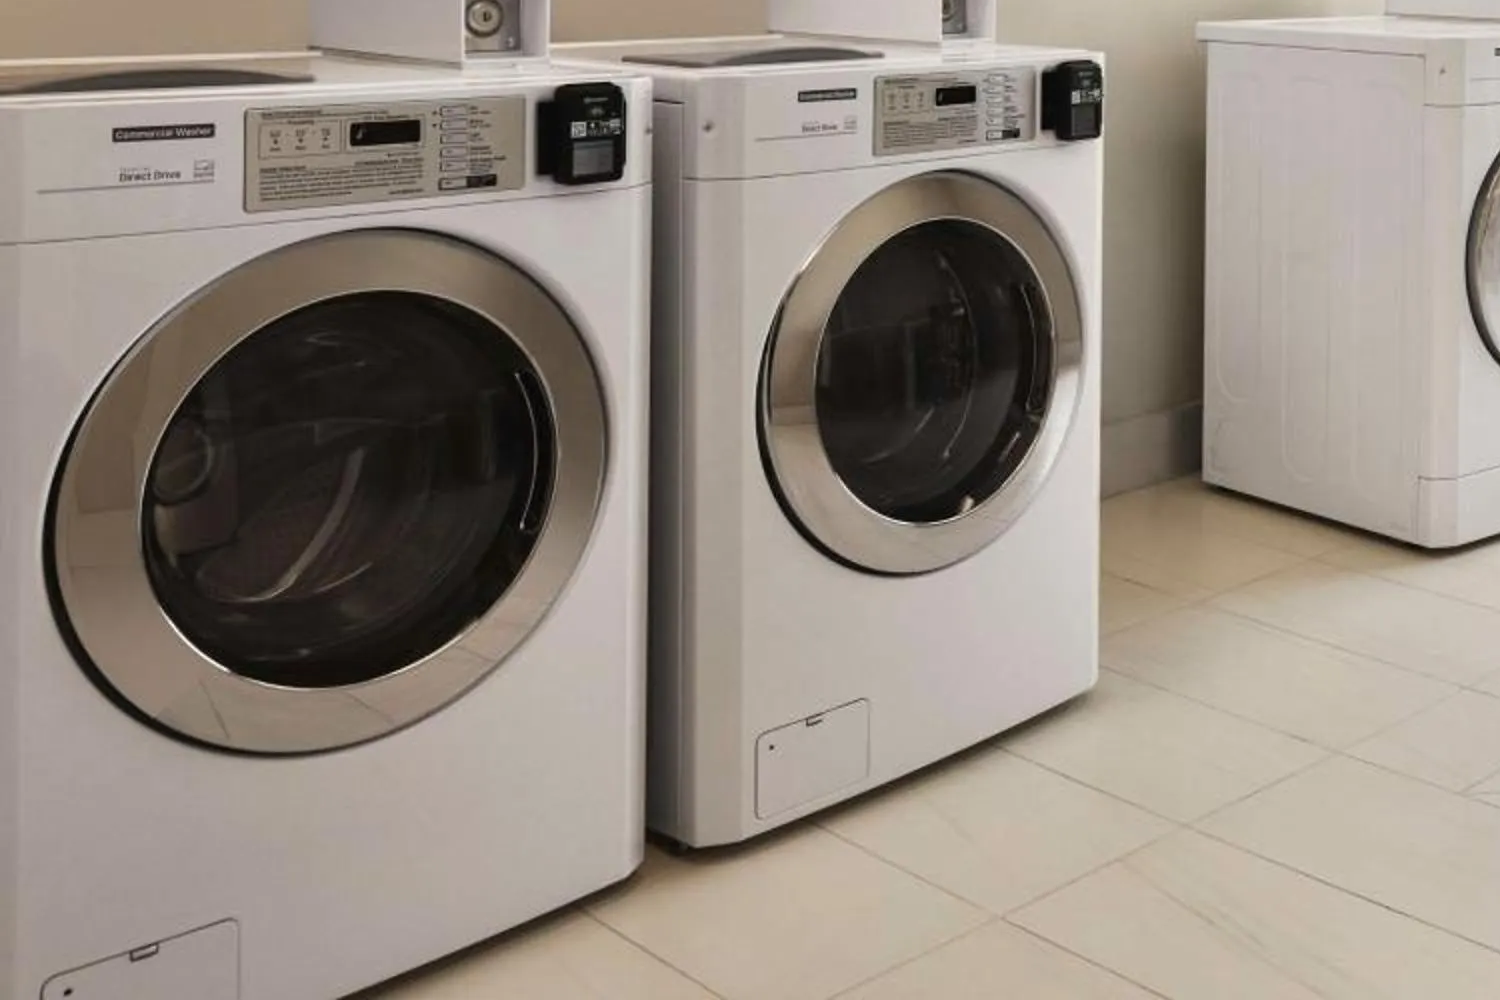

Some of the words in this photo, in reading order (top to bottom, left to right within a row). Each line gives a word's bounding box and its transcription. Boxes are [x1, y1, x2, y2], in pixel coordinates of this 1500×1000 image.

[115, 128, 173, 141] Commercial
[175, 126, 212, 137] Washer
[119, 171, 152, 182] Direct
[153, 168, 182, 180] Drive
